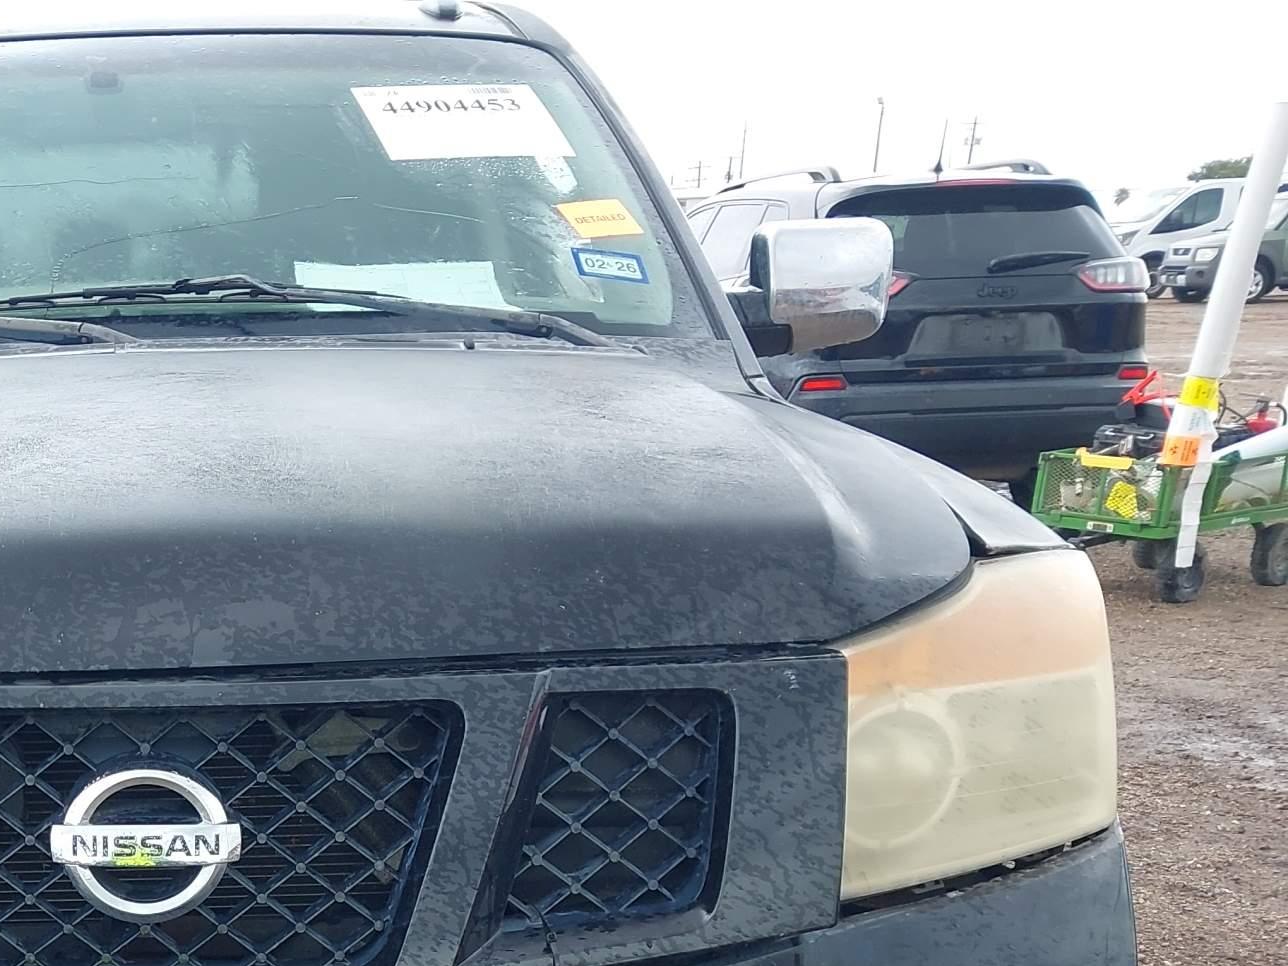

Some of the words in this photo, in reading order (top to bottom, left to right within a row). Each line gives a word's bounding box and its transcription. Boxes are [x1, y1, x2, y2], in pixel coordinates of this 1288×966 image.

[382, 98, 521, 114] 44904453
[575, 213, 626, 224] DETAILED
[976, 282, 1018, 300] Jeep
[72, 834, 220, 858] NISSAN
